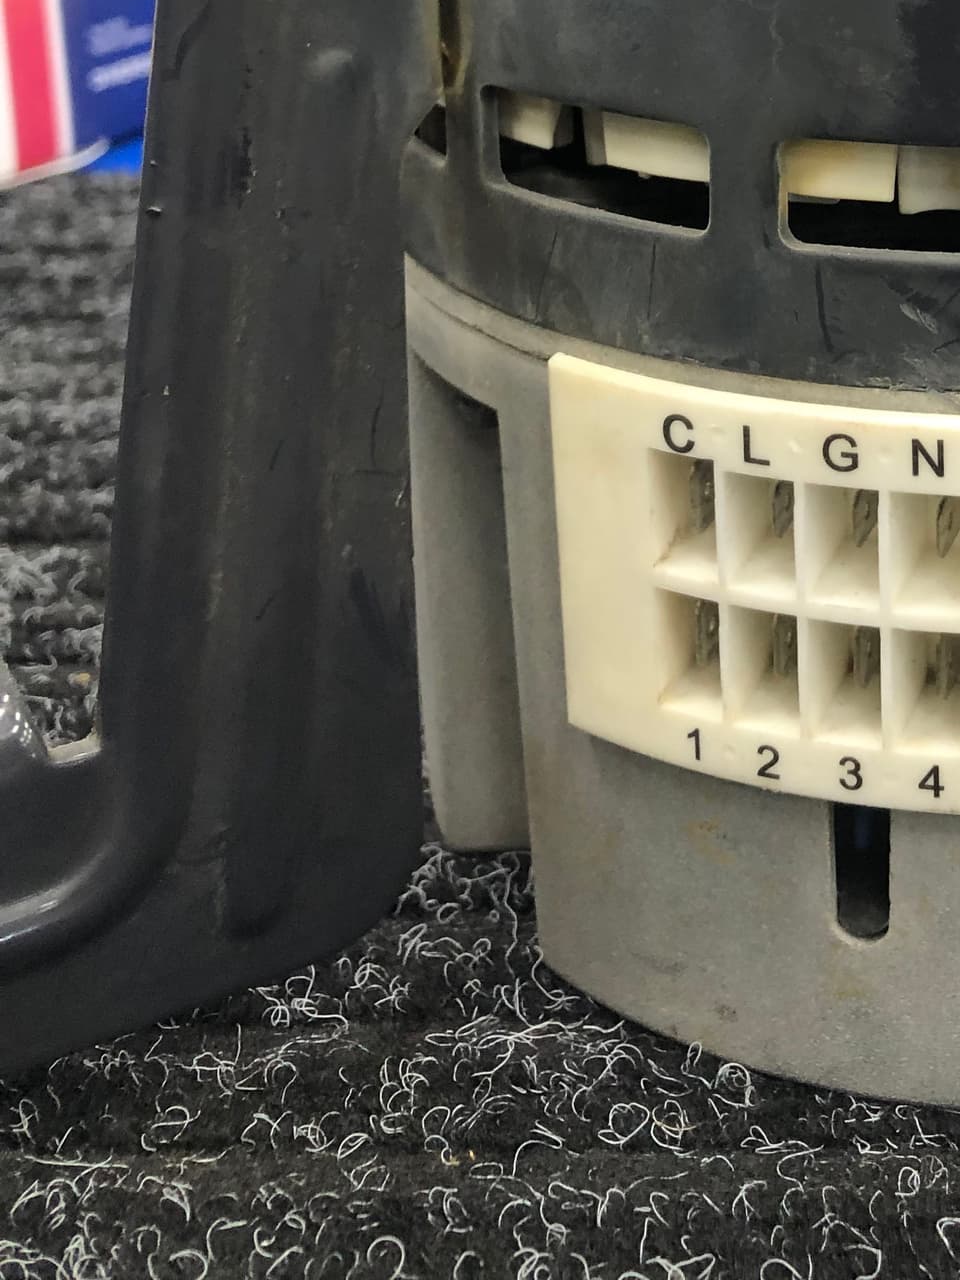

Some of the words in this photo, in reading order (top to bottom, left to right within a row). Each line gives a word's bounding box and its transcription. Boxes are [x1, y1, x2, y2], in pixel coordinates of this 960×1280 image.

[662, 413, 696, 454] C
[742, 424, 771, 467] L
[821, 433, 859, 473] G
[911, 438, 945, 478] N
[686, 727, 701, 761] 1
[756, 744, 781, 781] 2
[838, 756, 864, 791] 3
[917, 764, 945, 799] 4
